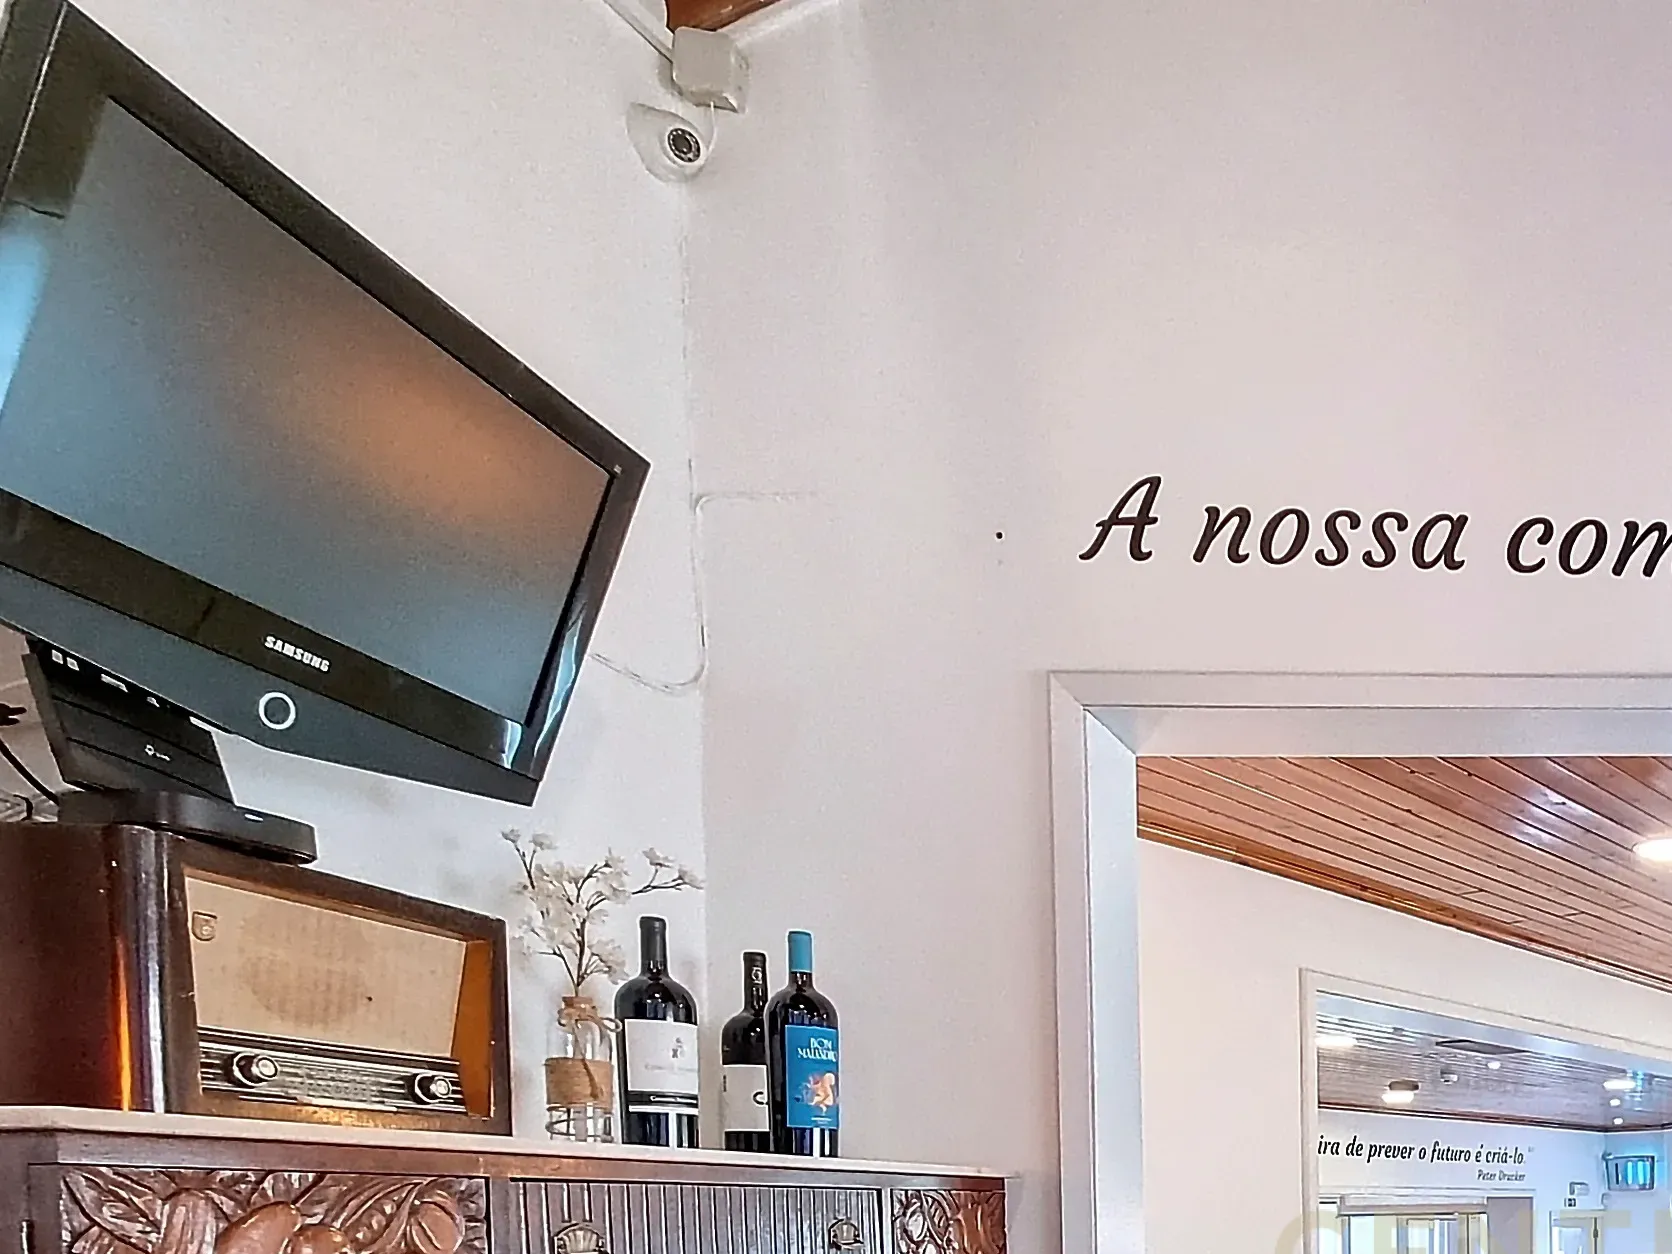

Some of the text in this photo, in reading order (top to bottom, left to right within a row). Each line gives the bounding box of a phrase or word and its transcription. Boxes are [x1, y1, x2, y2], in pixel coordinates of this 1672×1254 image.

[1078, 475, 1162, 562] A
[1192, 505, 1469, 571] nossa
[264, 635, 331, 672] SAMSUNG
[1345, 1134, 1364, 1157] de
[1366, 1143, 1416, 1164] prever
[1418, 1146, 1427, 1160] o
[1430, 1140, 1472, 1163] futuro
[1475, 1143, 1484, 1163] é
